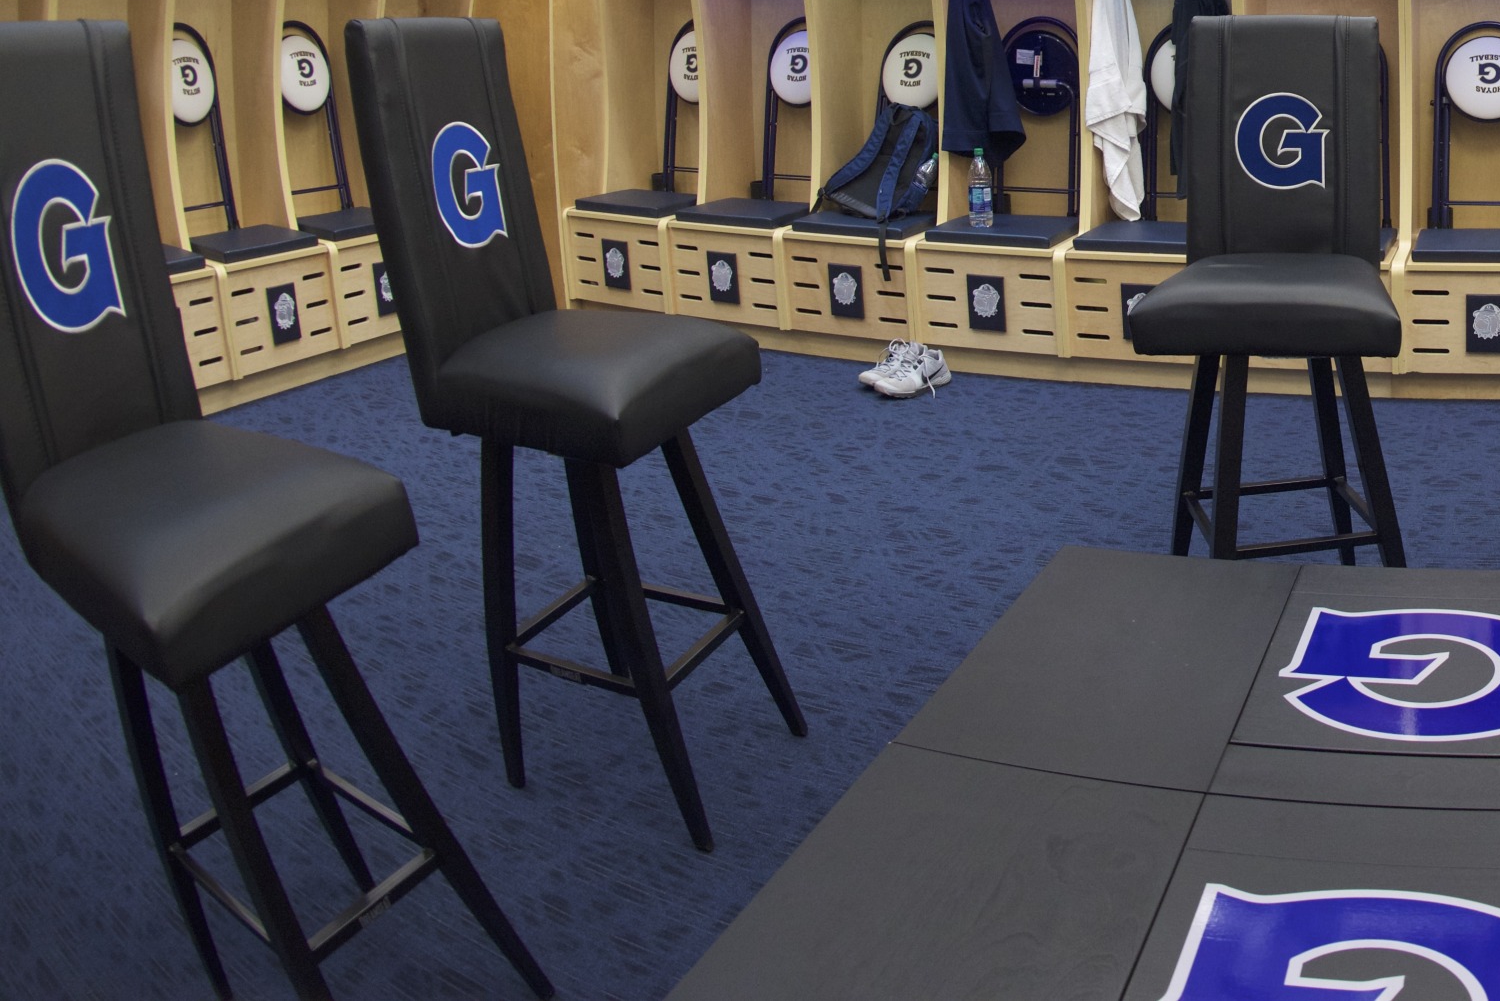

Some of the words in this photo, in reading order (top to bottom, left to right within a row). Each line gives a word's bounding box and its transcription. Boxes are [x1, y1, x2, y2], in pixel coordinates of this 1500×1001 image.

[899, 51, 930, 59] BASEBALL
[431, 121, 509, 249] G
[1235, 92, 1330, 190] G
[11, 158, 127, 333] G
